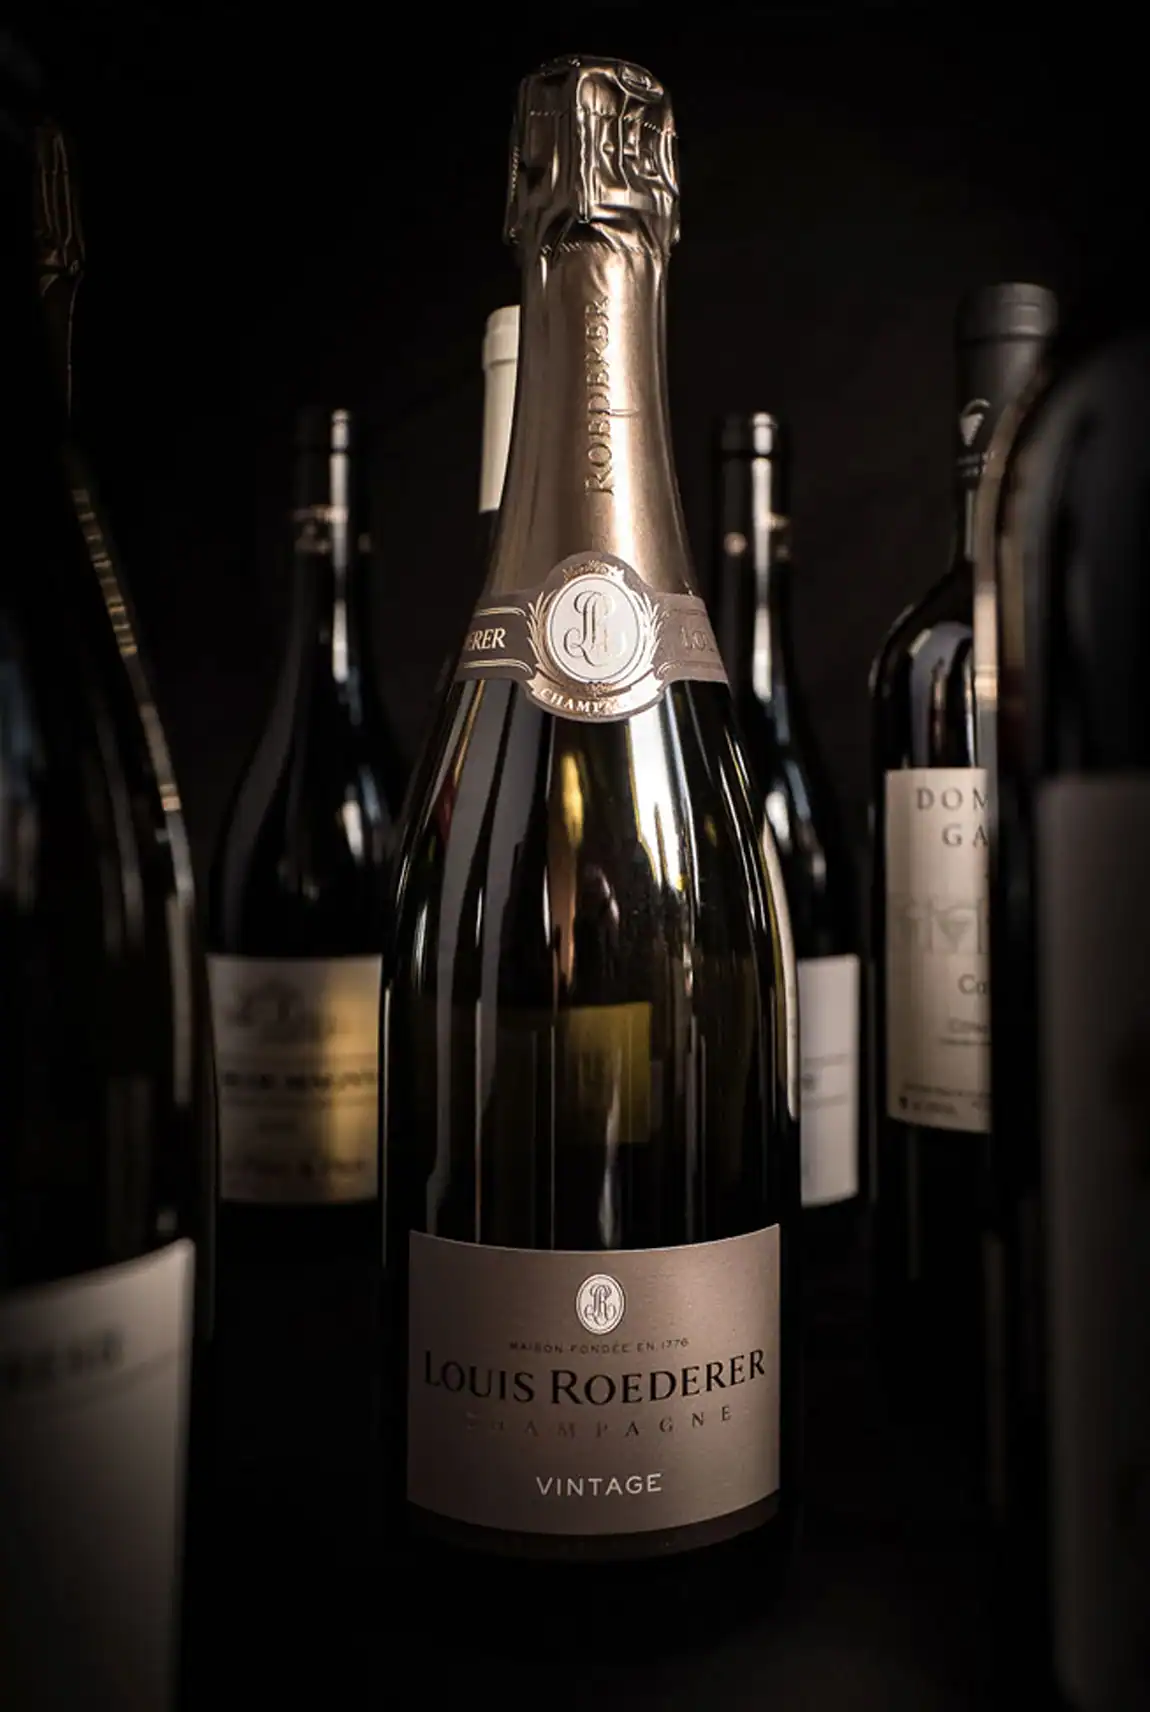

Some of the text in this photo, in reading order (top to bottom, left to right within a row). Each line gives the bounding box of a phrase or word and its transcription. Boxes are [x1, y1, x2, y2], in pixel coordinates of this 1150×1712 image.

[584, 296, 615, 496] ROEDERER
[509, 1340, 563, 1354] MAISON
[425, 1349, 765, 1406] LOUIS ROEDERER
[465, 1405, 732, 1438] HAMPAGNE
[536, 1473, 662, 1497] VINTAGE
